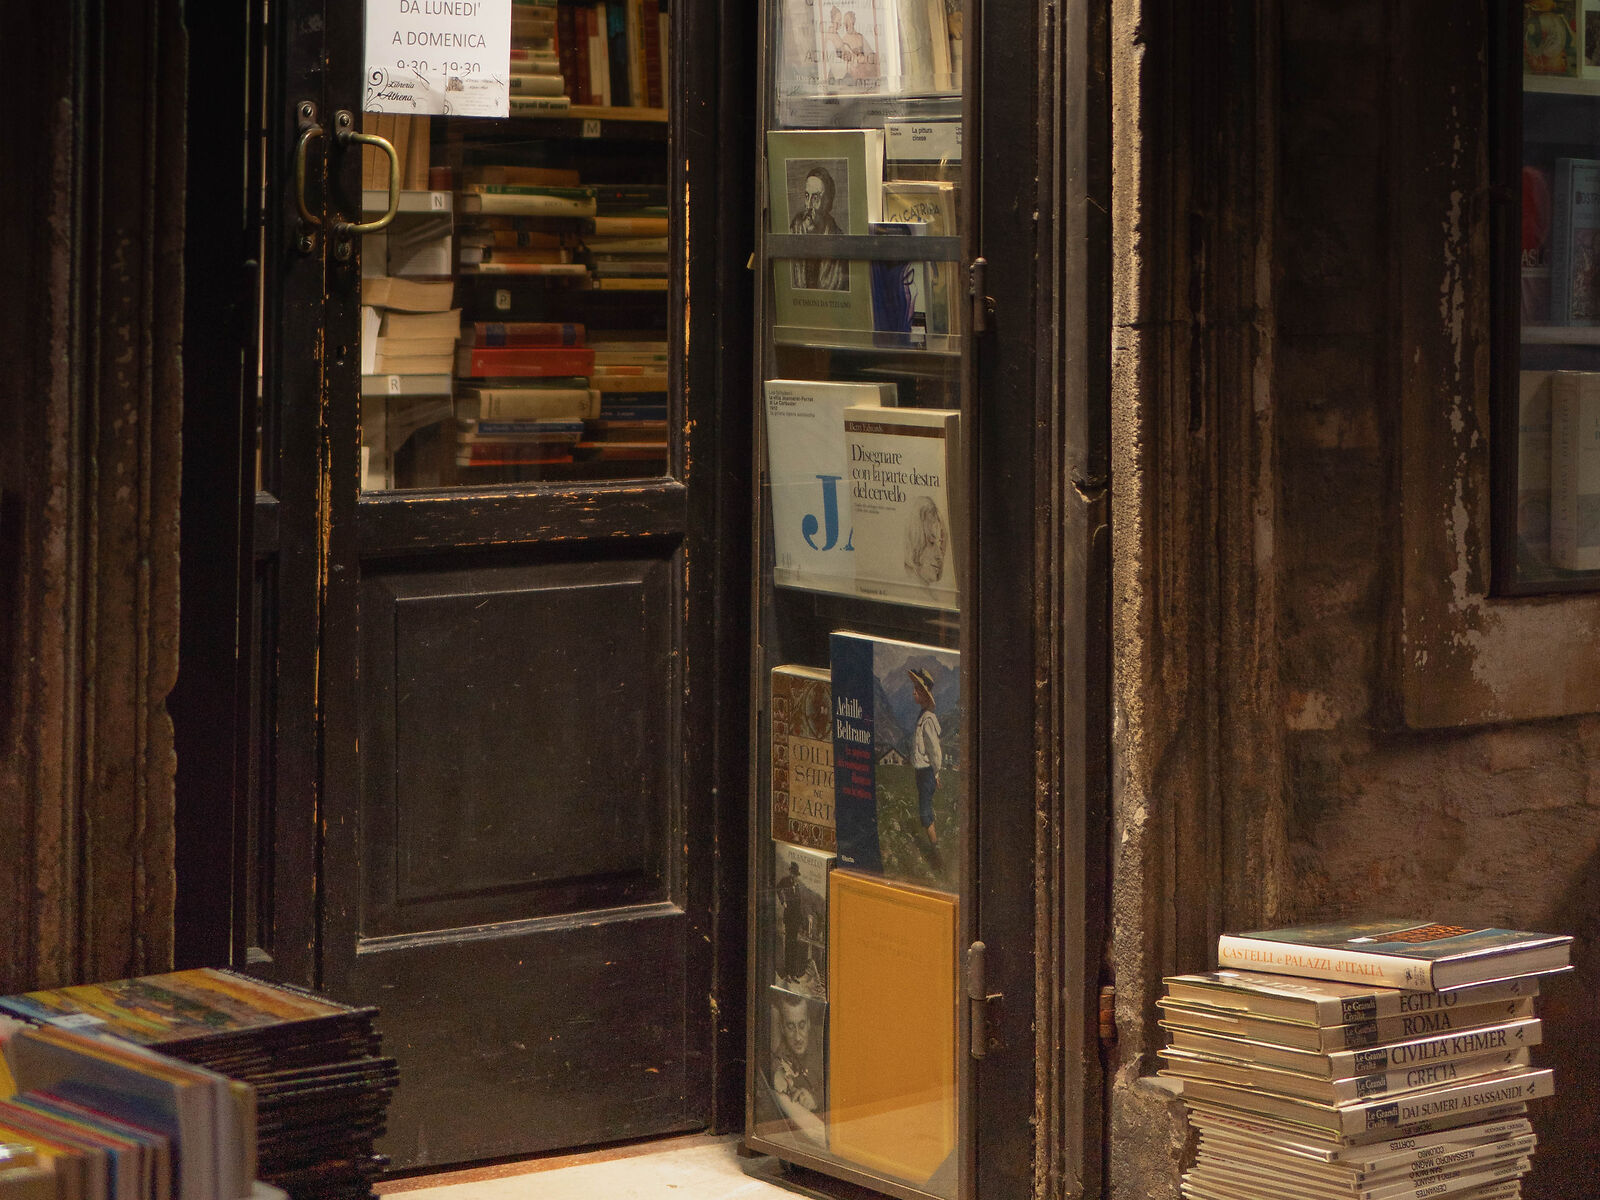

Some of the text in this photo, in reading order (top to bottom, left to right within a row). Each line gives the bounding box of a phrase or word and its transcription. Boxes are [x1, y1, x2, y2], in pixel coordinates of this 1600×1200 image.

[400, 0, 481, 17] DA LUNEDI'
[392, 31, 486, 48] A DOMENICA
[387, 81, 415, 89] Libreria
[382, 91, 413, 102] Athena
[587, 122, 599, 133] M
[434, 196, 442, 208] N
[390, 379, 399, 391] R
[851, 444, 902, 467] Disegnare
[852, 464, 940, 487] con la parte destra
[853, 481, 906, 502] del cervello
[836, 695, 864, 719] Achille
[836, 718, 871, 745] Beltrame
[1221, 947, 1384, 977] CASTELLI e PALAZZI d'ITALIA
[1343, 999, 1376, 1011] Le Grandi
[1400, 991, 1458, 1013] EGITTO
[1403, 1013, 1451, 1036] ROMA
[1452, 1028, 1506, 1054] KHMER
[1355, 1050, 1387, 1062] Le Grandi
[1407, 1063, 1457, 1087] GRECIA
[1357, 1078, 1386, 1090] Le Grandi
[1402, 1085, 1522, 1120] DAI SUMERI AI SASSANIDI
[1367, 1106, 1399, 1120] Le Grandi
[1389, 1139, 1416, 1151] CORTES
[1417, 1146, 1445, 1159] COLOMBO
[1411, 1150, 1475, 1171] ALESSANDRO MAGNO
[1415, 1184, 1447, 1198] CERVANTES
